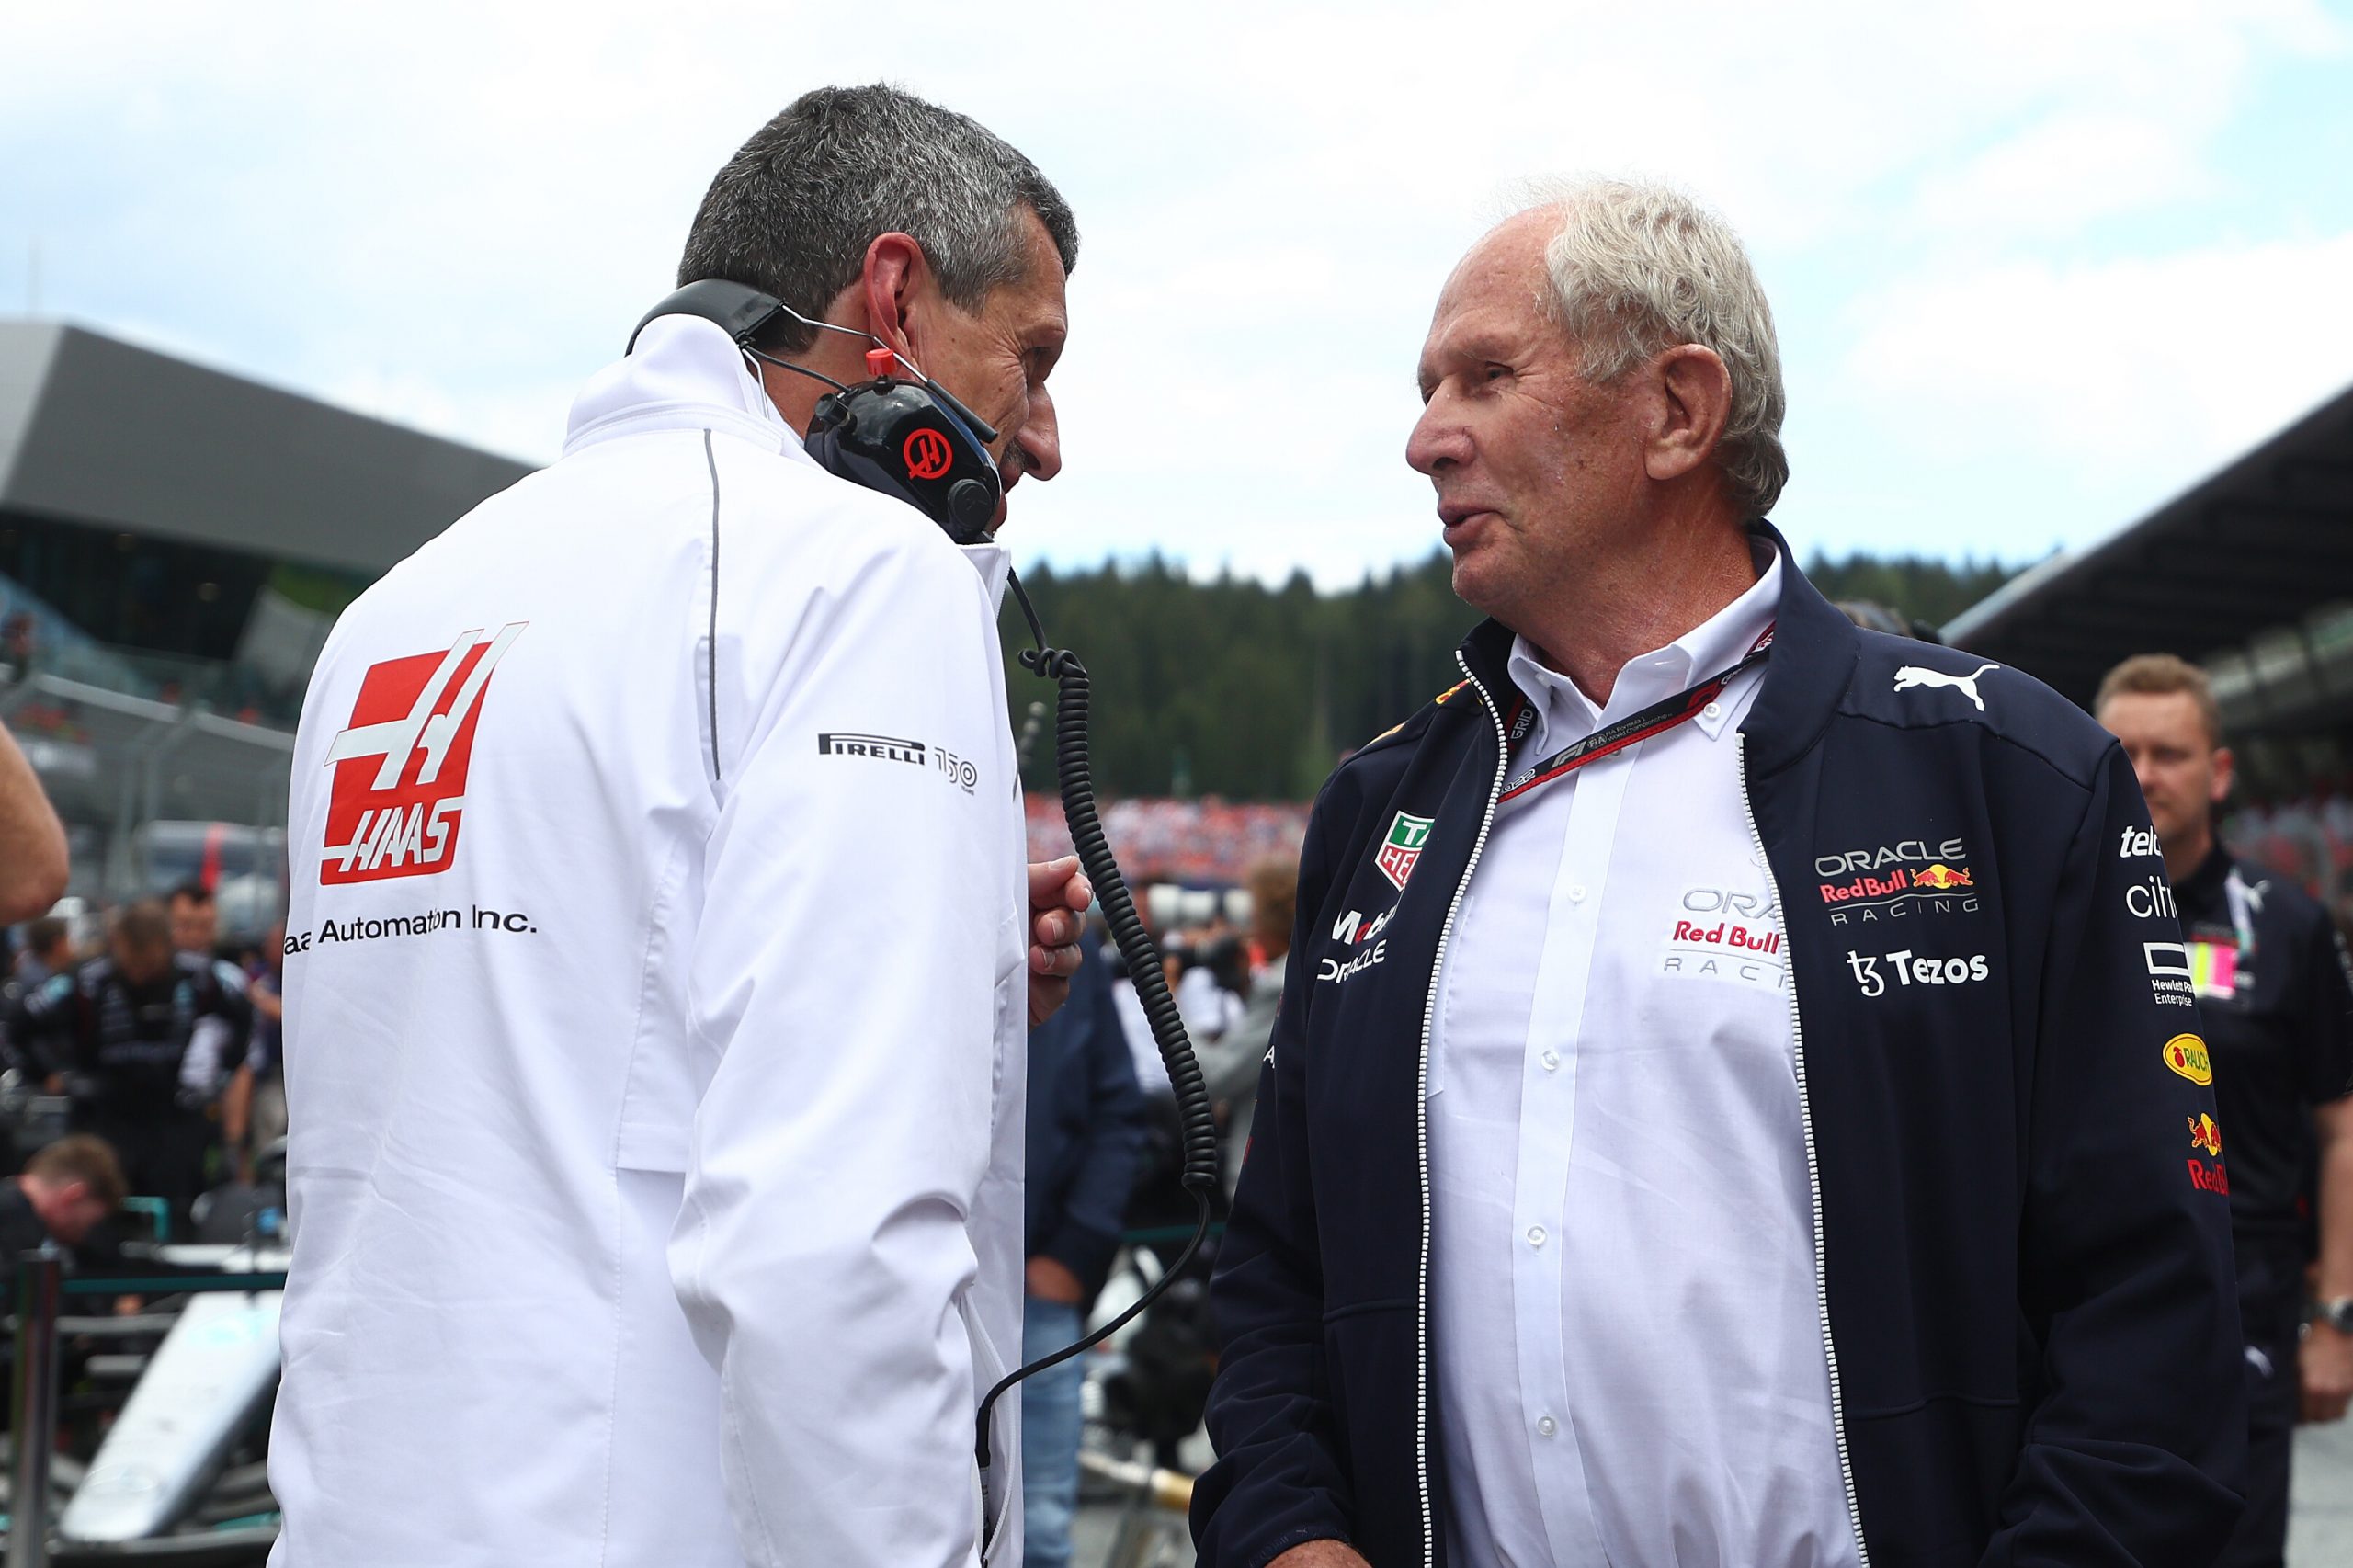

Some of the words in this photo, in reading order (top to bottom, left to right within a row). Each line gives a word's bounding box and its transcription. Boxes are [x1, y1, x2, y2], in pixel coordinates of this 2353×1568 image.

[1510, 709, 1533, 739] GRID
[818, 733, 926, 765] PIRELLI
[934, 747, 977, 787] 150
[1502, 768, 1536, 792] 022
[323, 796, 464, 872] HAAS
[1815, 838, 1966, 877] ORACLE
[472, 904, 537, 933] Inc.
[1831, 898, 1979, 926] RACING
[1673, 920, 1725, 943] Red
[1728, 926, 1780, 954] Bull
[1885, 949, 1989, 985] Tezos
